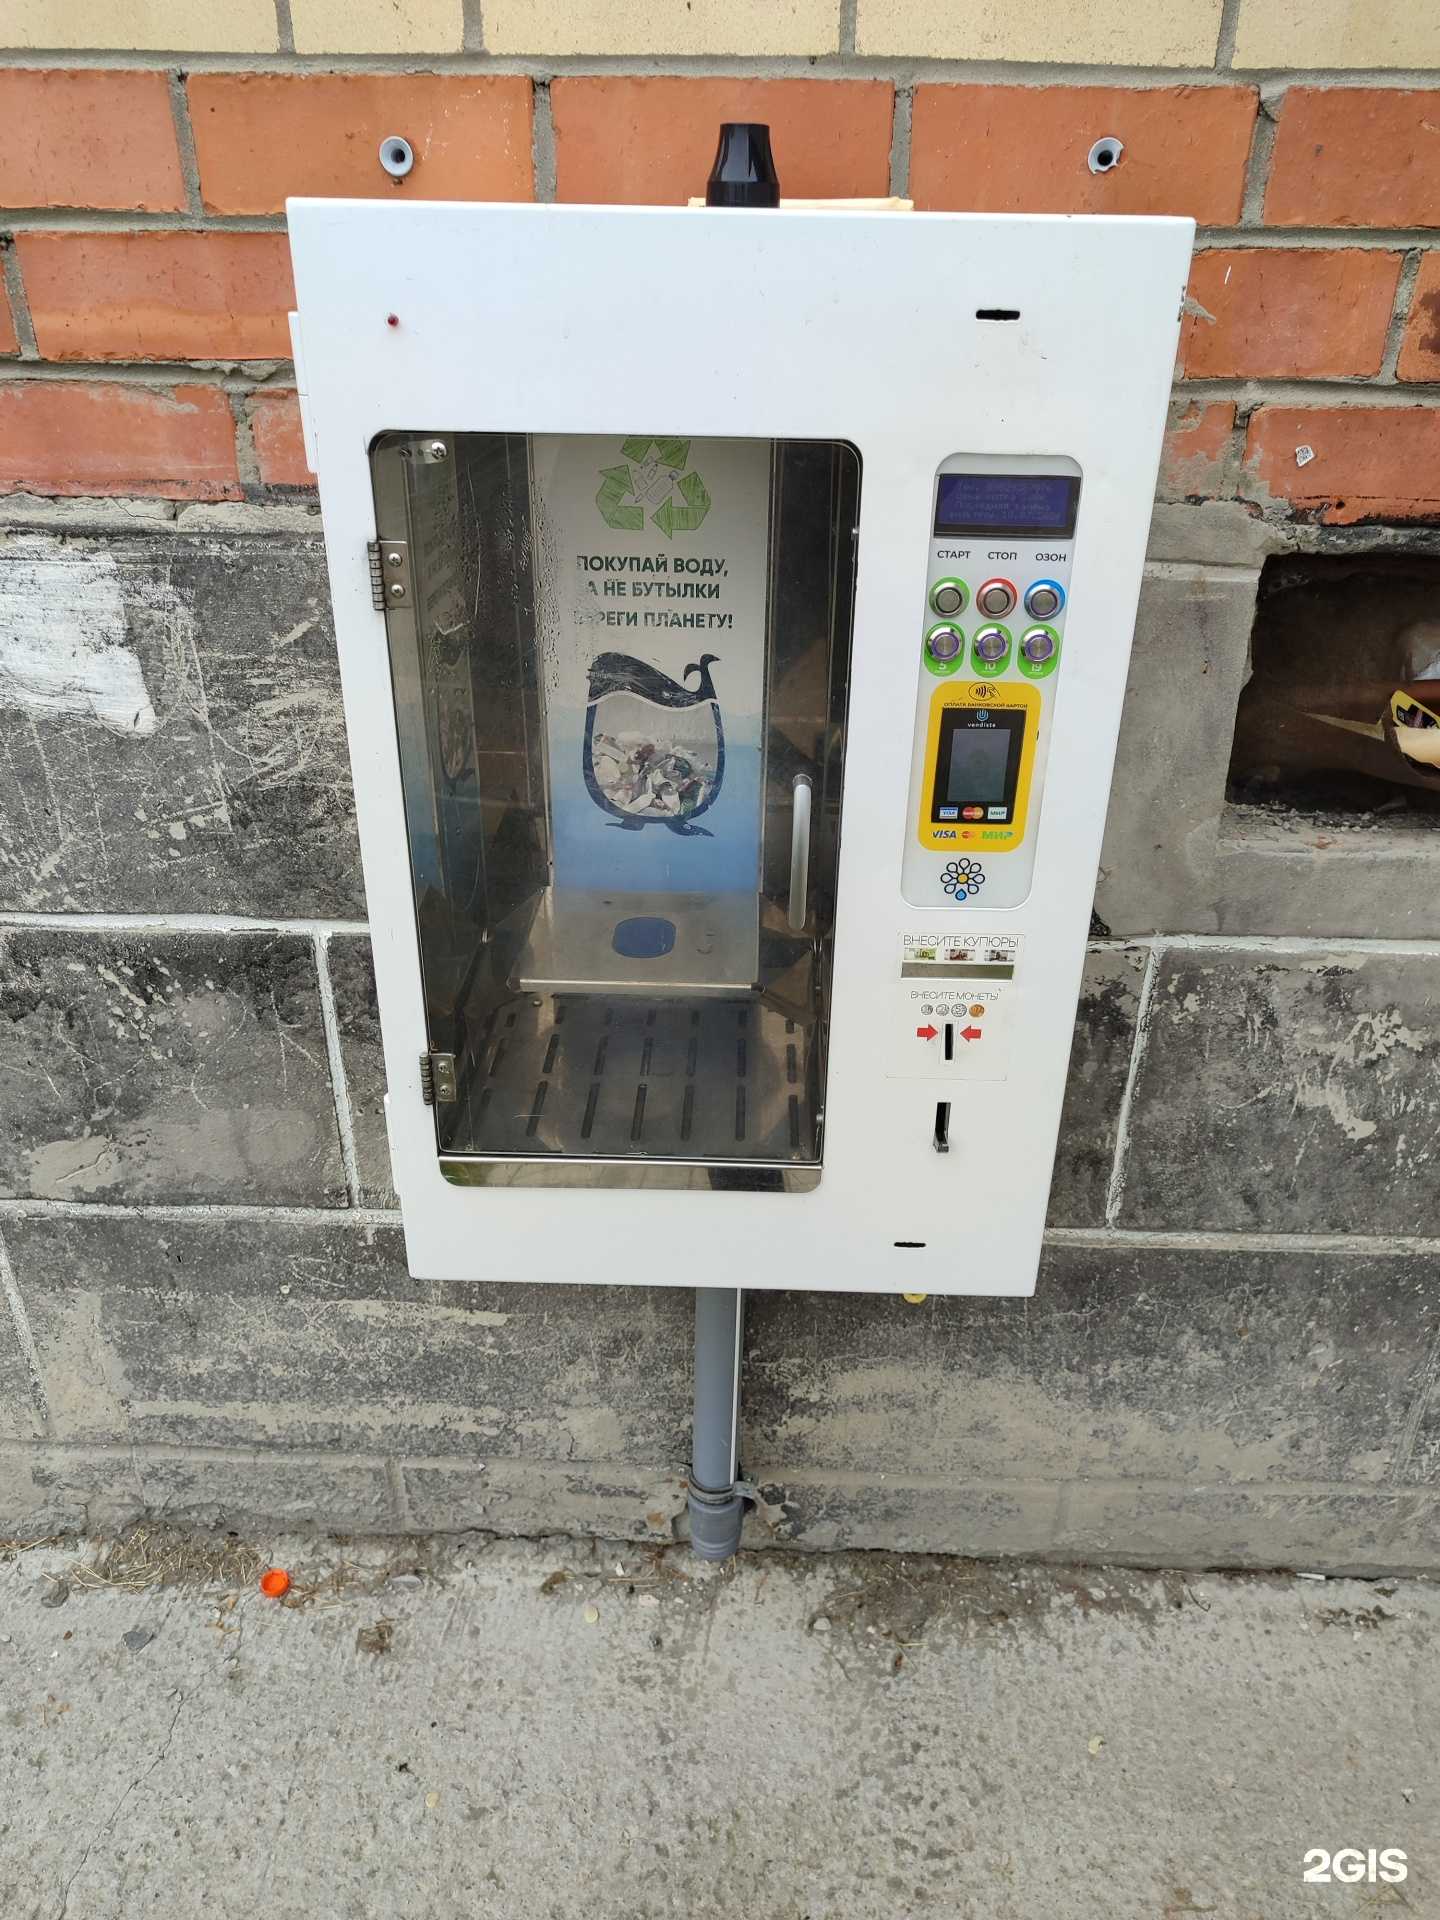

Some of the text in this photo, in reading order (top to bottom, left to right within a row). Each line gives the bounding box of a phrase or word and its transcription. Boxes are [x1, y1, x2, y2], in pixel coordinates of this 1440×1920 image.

[937, 550, 971, 559] СТАРТ
[987, 551, 1017, 560] СТОП
[1035, 553, 1067, 562] ОЗОН
[674, 558, 729, 577] ВОДУ,
[603, 581, 626, 596] НЕ
[632, 582, 720, 599] БУТЫЛКИ
[643, 611, 733, 629] ПЛАНЕТУ!
[984, 662, 996, 670] 10
[932, 830, 957, 839] VISA
[903, 935, 1019, 948] ВНЕСИТЕ КУПЮРЫ
[910, 990, 999, 1001] ВНЕСИТЕ МОНЕТЫ
